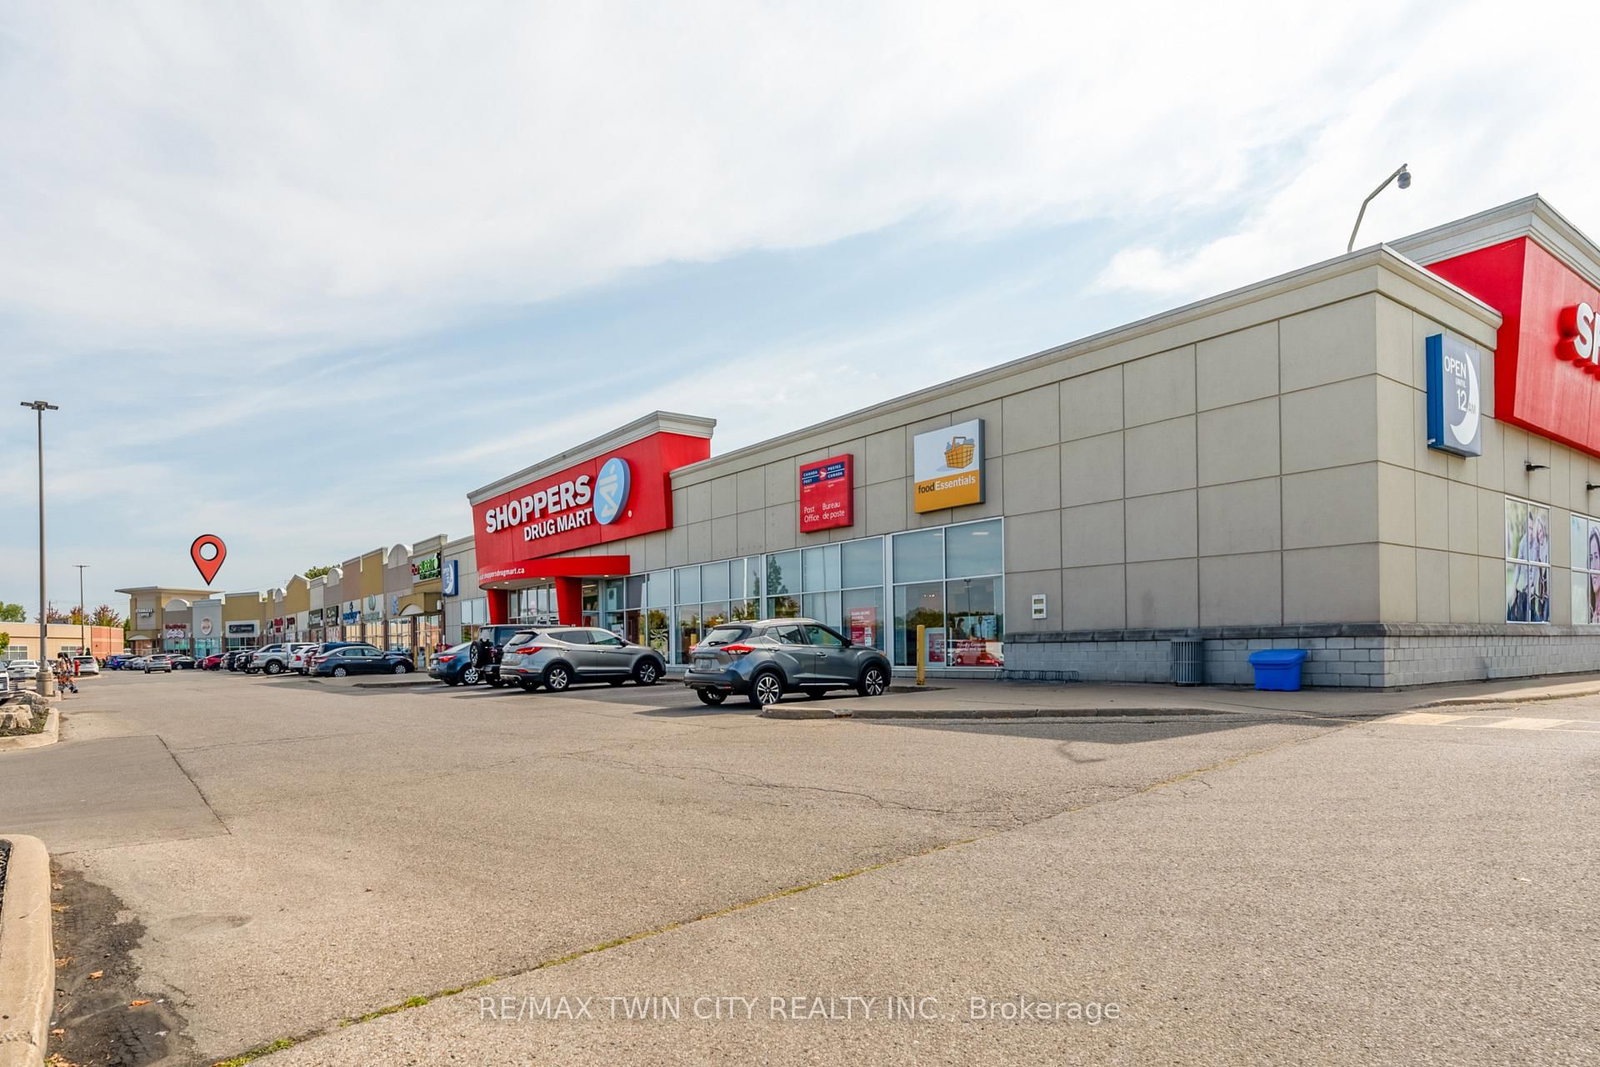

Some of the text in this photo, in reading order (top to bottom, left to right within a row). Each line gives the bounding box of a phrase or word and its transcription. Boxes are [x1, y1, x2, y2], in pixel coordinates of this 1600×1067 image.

[1444, 356, 1467, 379] OPEN
[1456, 388, 1467, 412] 12
[485, 474, 591, 534] SHOPPERS
[822, 502, 840, 510] Bureau
[830, 510, 845, 520] poste
[523, 507, 593, 542] DRUG MART
[804, 514, 820, 522] Office
